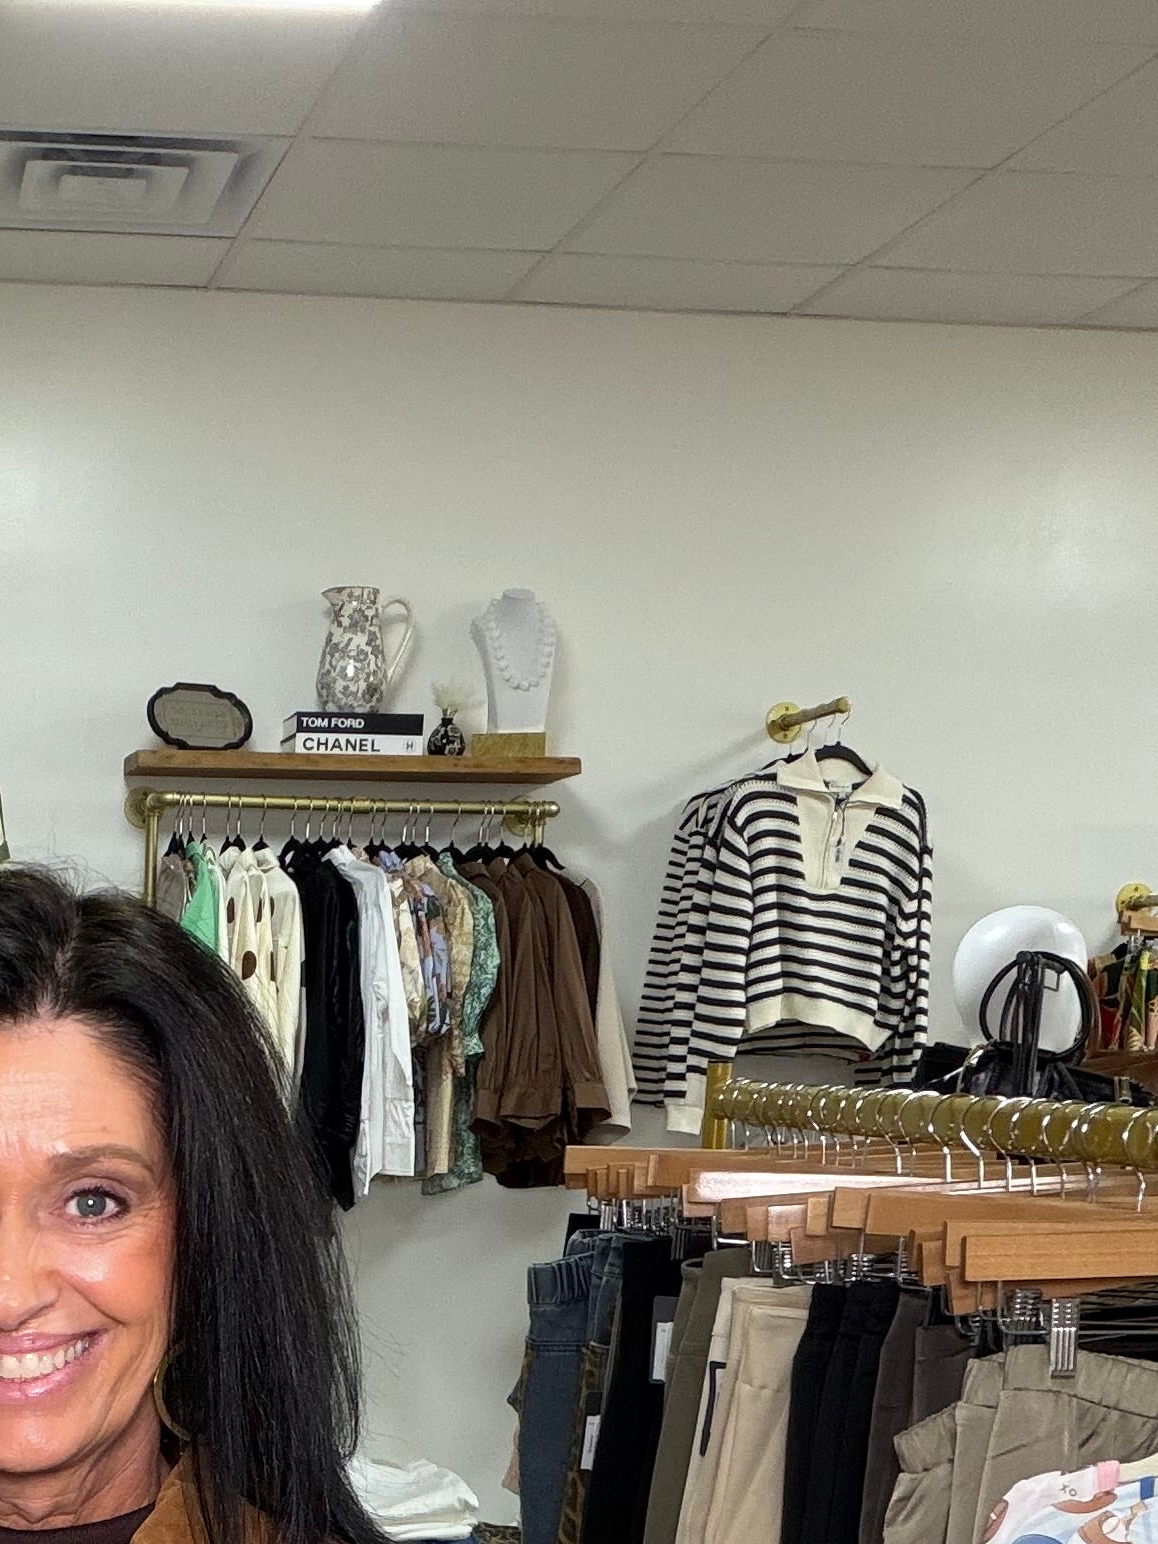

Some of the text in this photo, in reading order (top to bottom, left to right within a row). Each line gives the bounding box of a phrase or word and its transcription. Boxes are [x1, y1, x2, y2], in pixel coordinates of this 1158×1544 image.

[300, 716, 365, 729] TOM FORD
[302, 737, 381, 753] CHANEL
